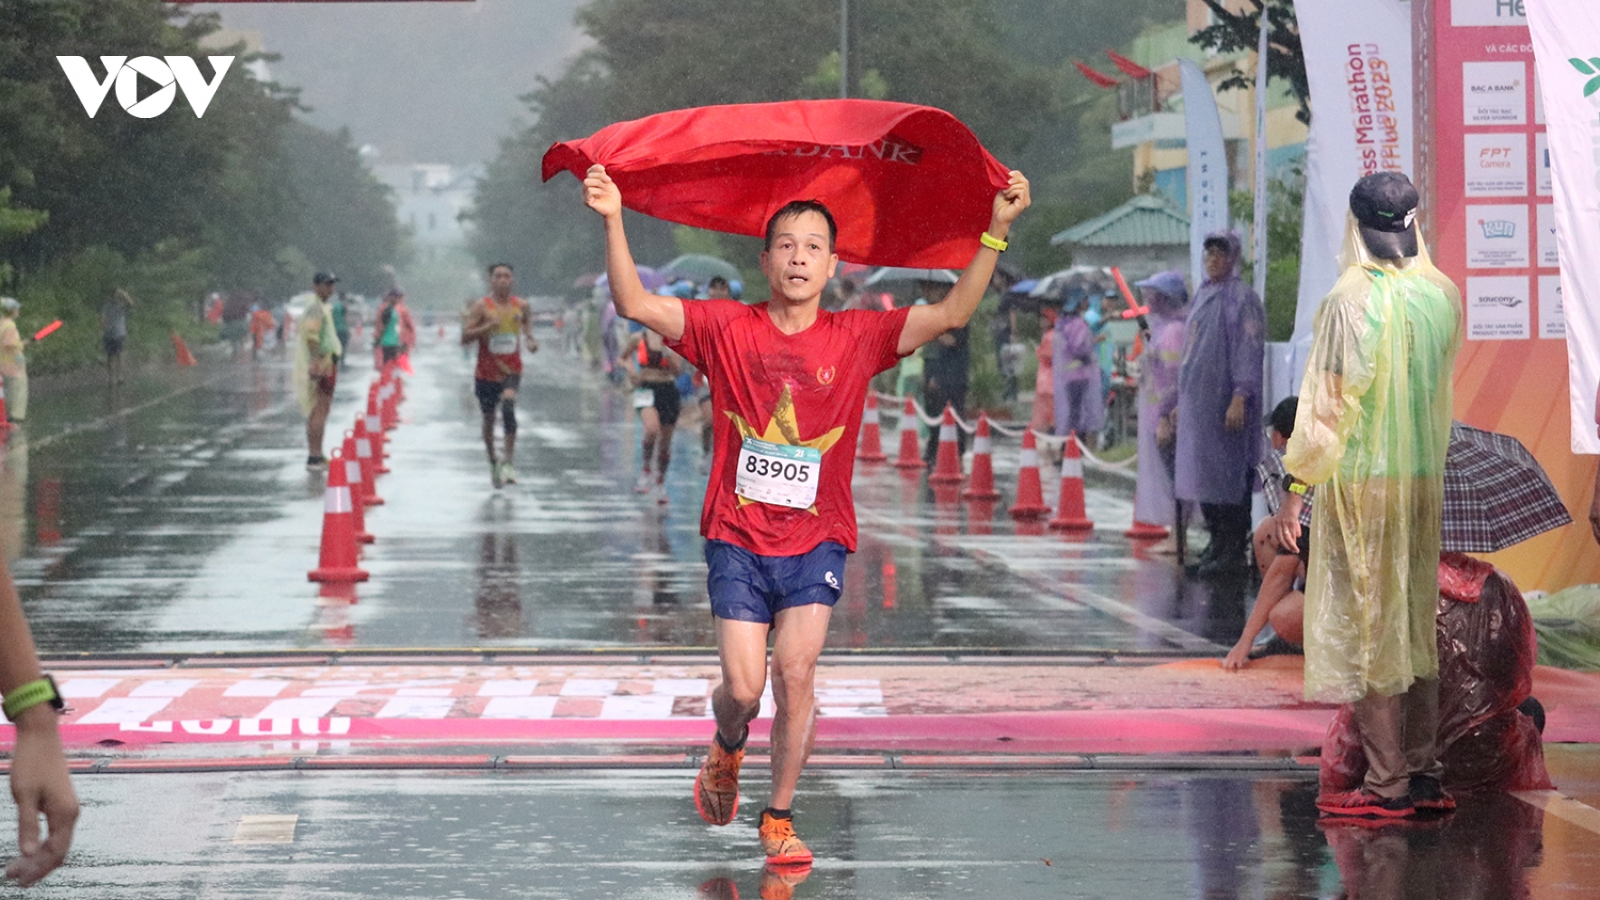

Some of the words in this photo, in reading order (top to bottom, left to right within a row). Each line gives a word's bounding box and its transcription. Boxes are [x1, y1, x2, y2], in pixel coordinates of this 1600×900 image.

[1495, 0, 1527, 17] He
[1499, 43, 1518, 53] CÁC
[1520, 43, 1535, 53] ĐỐ
[1347, 43, 1375, 145] Marathon
[1370, 59, 1396, 113] 2023
[764, 138, 920, 166] BANK
[1480, 148, 1512, 158] FPT
[1480, 160, 1511, 168] Camera
[745, 455, 811, 483] 83905
